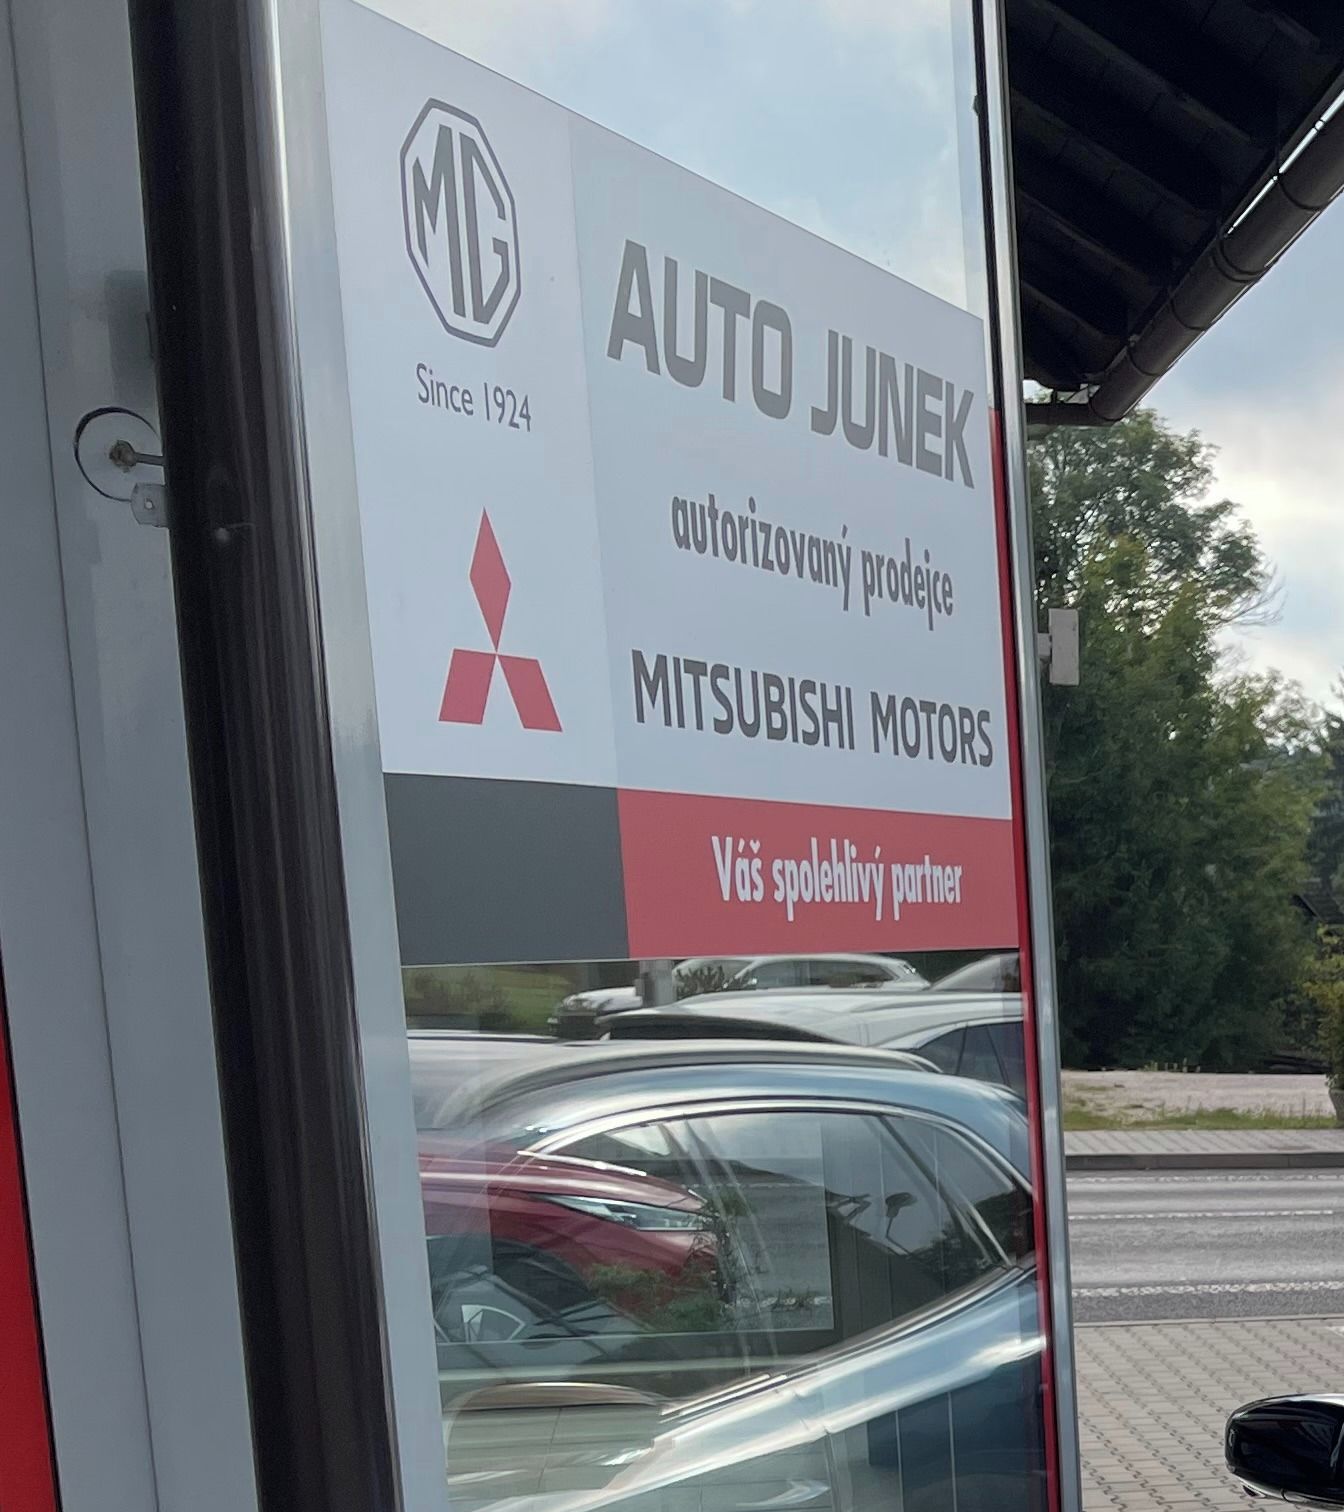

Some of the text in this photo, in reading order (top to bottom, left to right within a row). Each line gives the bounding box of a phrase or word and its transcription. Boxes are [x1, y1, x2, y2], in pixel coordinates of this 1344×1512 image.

[411, 122, 509, 327] MG
[416, 363, 532, 433] Since 1924
[606, 239, 976, 489] AUTO JUNEK
[671, 494, 954, 632] autorizovaný prodejce
[631, 649, 994, 768] MITSUBISHI MOTORS
[711, 835, 963, 921] Váš spolehlivý partner
